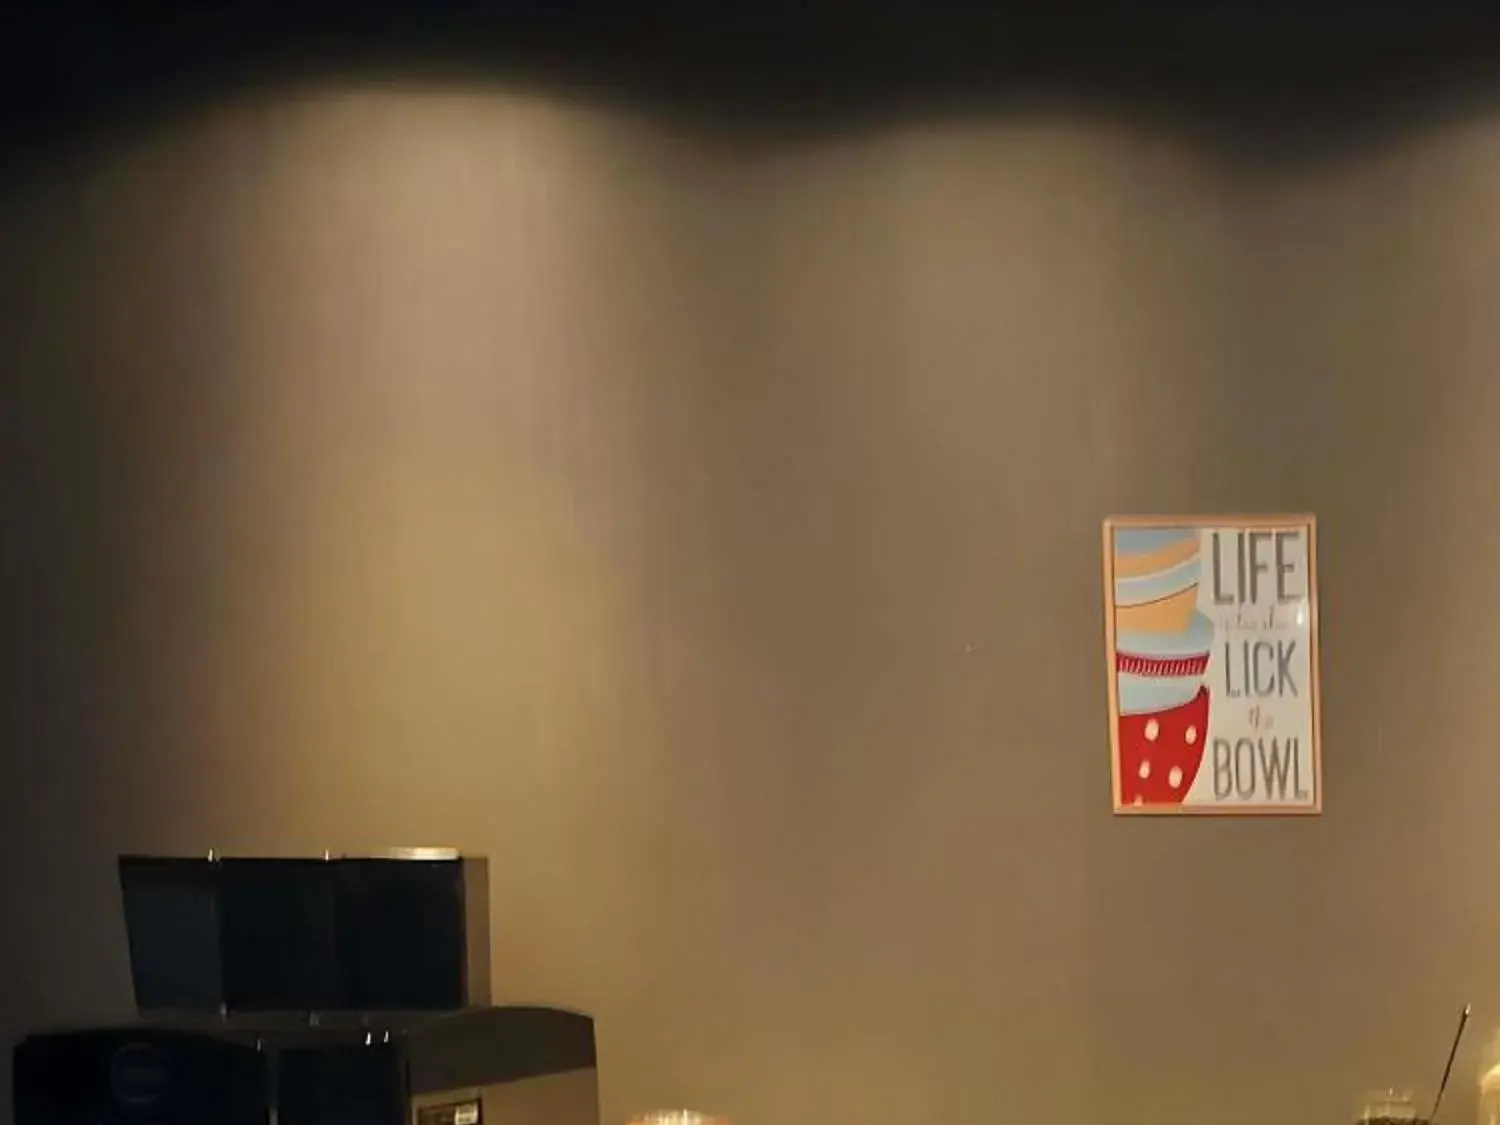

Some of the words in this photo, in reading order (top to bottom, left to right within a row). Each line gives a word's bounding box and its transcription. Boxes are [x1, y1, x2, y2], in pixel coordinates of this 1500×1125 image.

[1211, 531, 1303, 606] LIFE
[1224, 639, 1299, 699] LICK
[1213, 736, 1309, 801] BOWL
